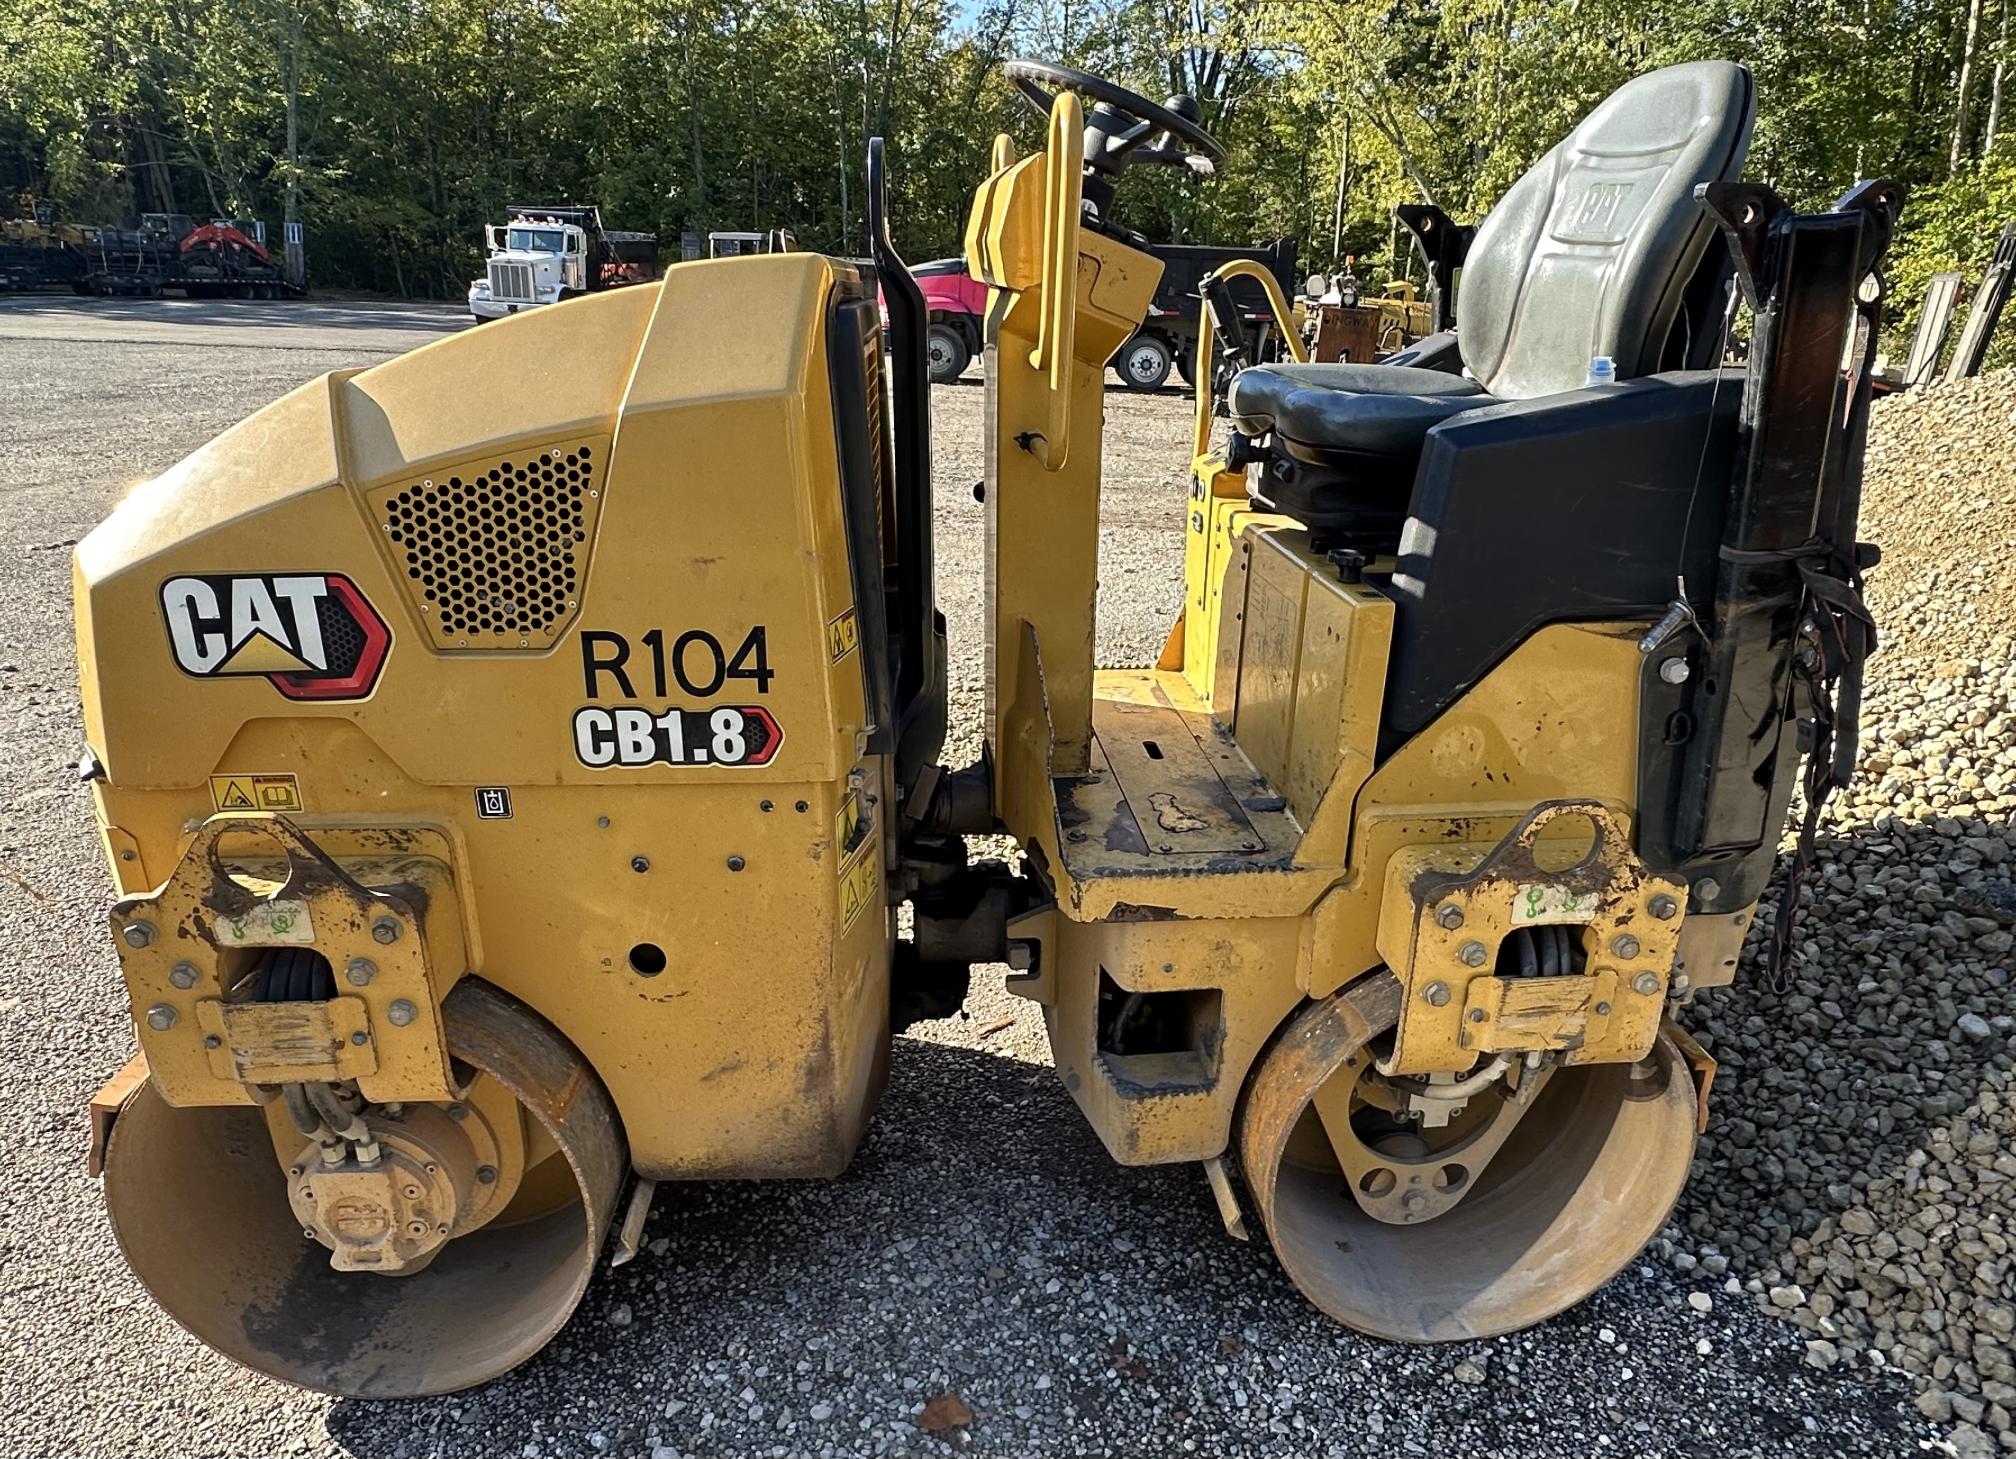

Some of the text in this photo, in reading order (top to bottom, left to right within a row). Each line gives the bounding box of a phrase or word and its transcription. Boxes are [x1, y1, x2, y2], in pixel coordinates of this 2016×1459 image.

[1572, 183, 1634, 232] CAT
[163, 576, 328, 674] CAT
[580, 626, 774, 698] R104
[576, 709, 746, 765] CB1.8
